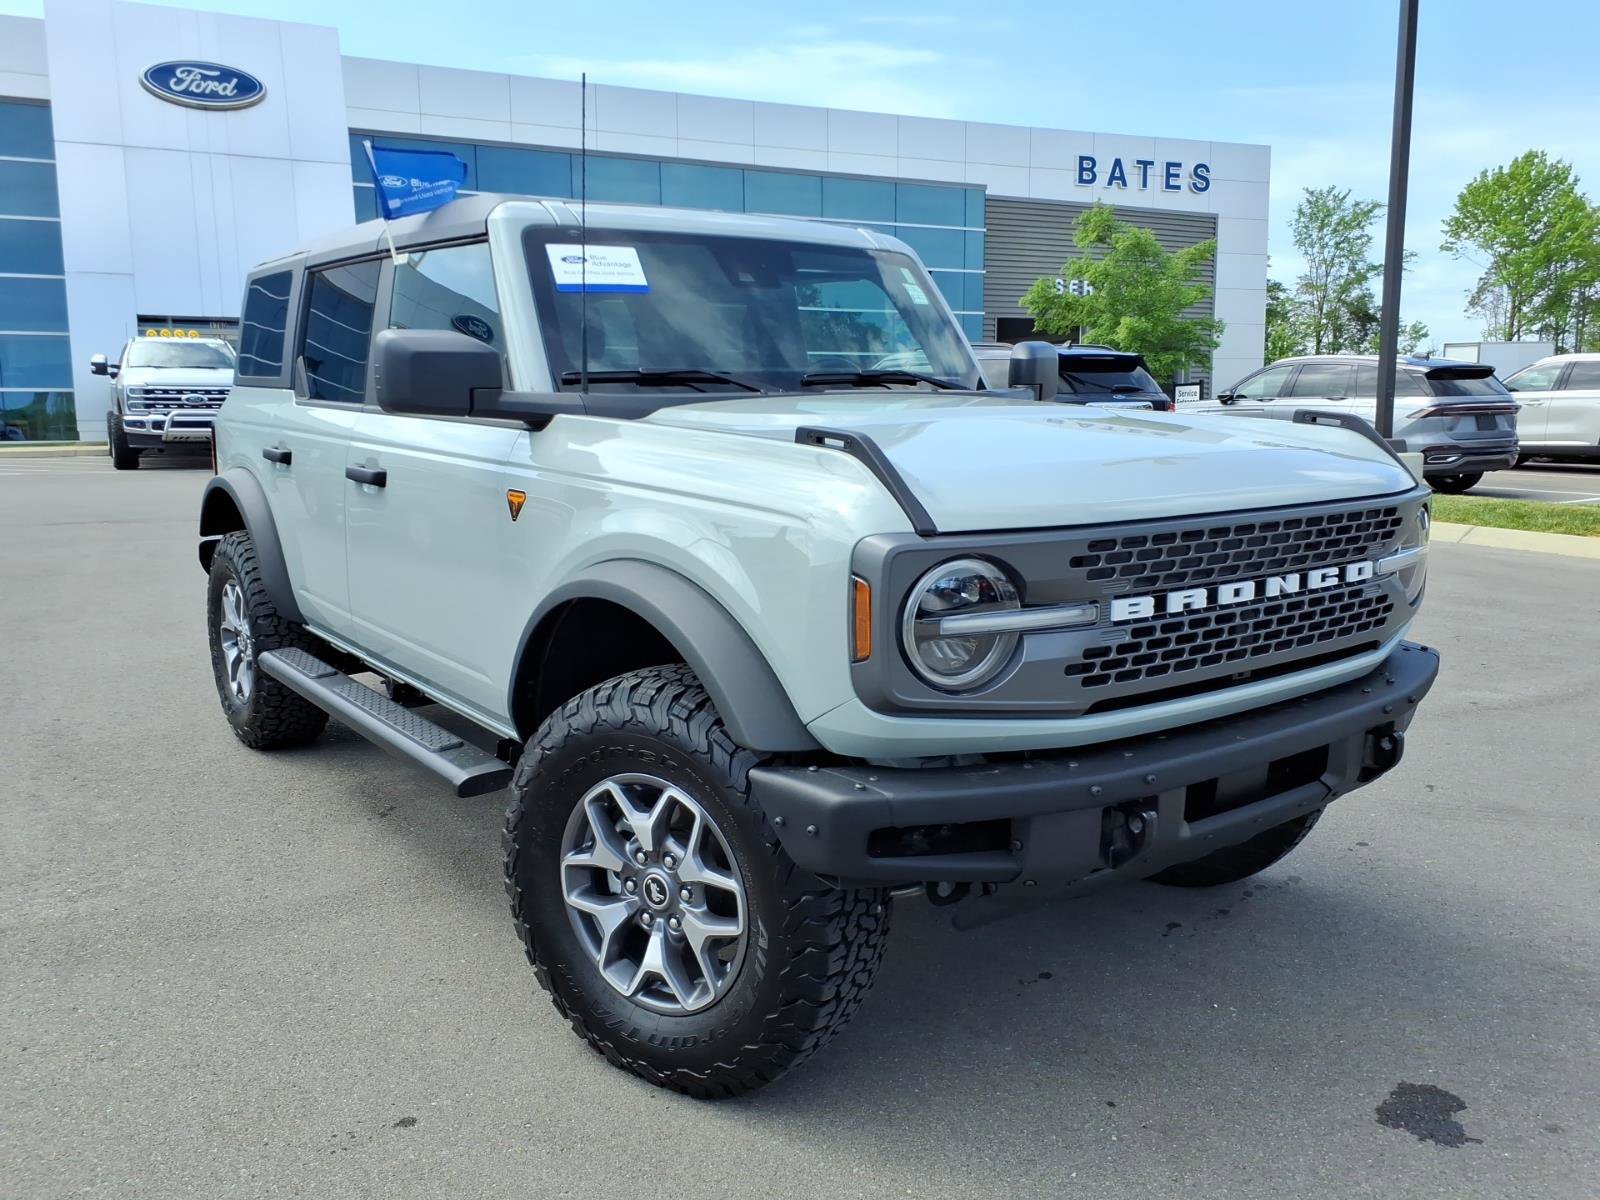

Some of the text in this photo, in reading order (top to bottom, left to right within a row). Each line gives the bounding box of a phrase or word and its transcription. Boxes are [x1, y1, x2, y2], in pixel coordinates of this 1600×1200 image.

[169, 66, 238, 96] Ford
[1076, 155, 1211, 193] BATES
[1178, 390, 1198, 398] Service
[1111, 560, 1373, 622] BRONCO
